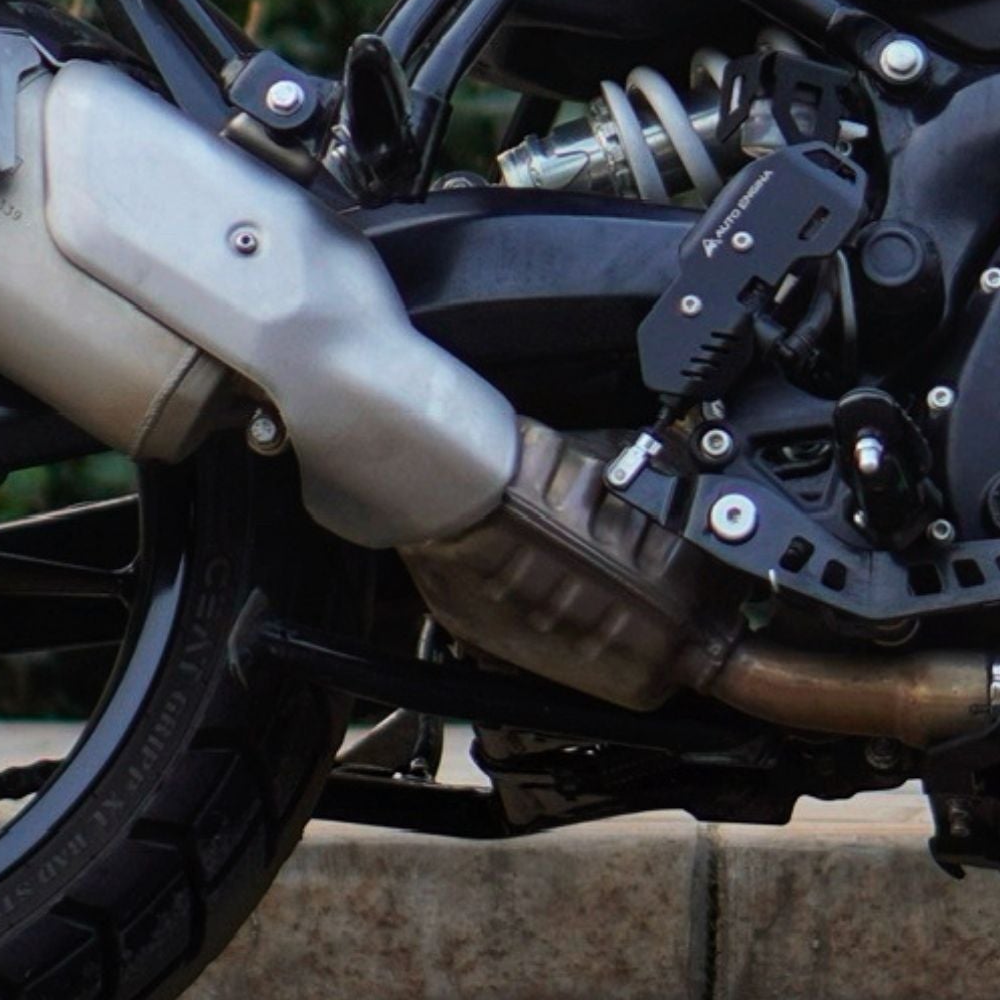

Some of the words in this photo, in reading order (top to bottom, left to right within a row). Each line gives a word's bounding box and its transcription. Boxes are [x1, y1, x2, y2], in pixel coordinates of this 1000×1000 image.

[716, 208, 741, 238] AUTO
[179, 556, 231, 682] CEAT
[126, 690, 187, 791] GRIPP
